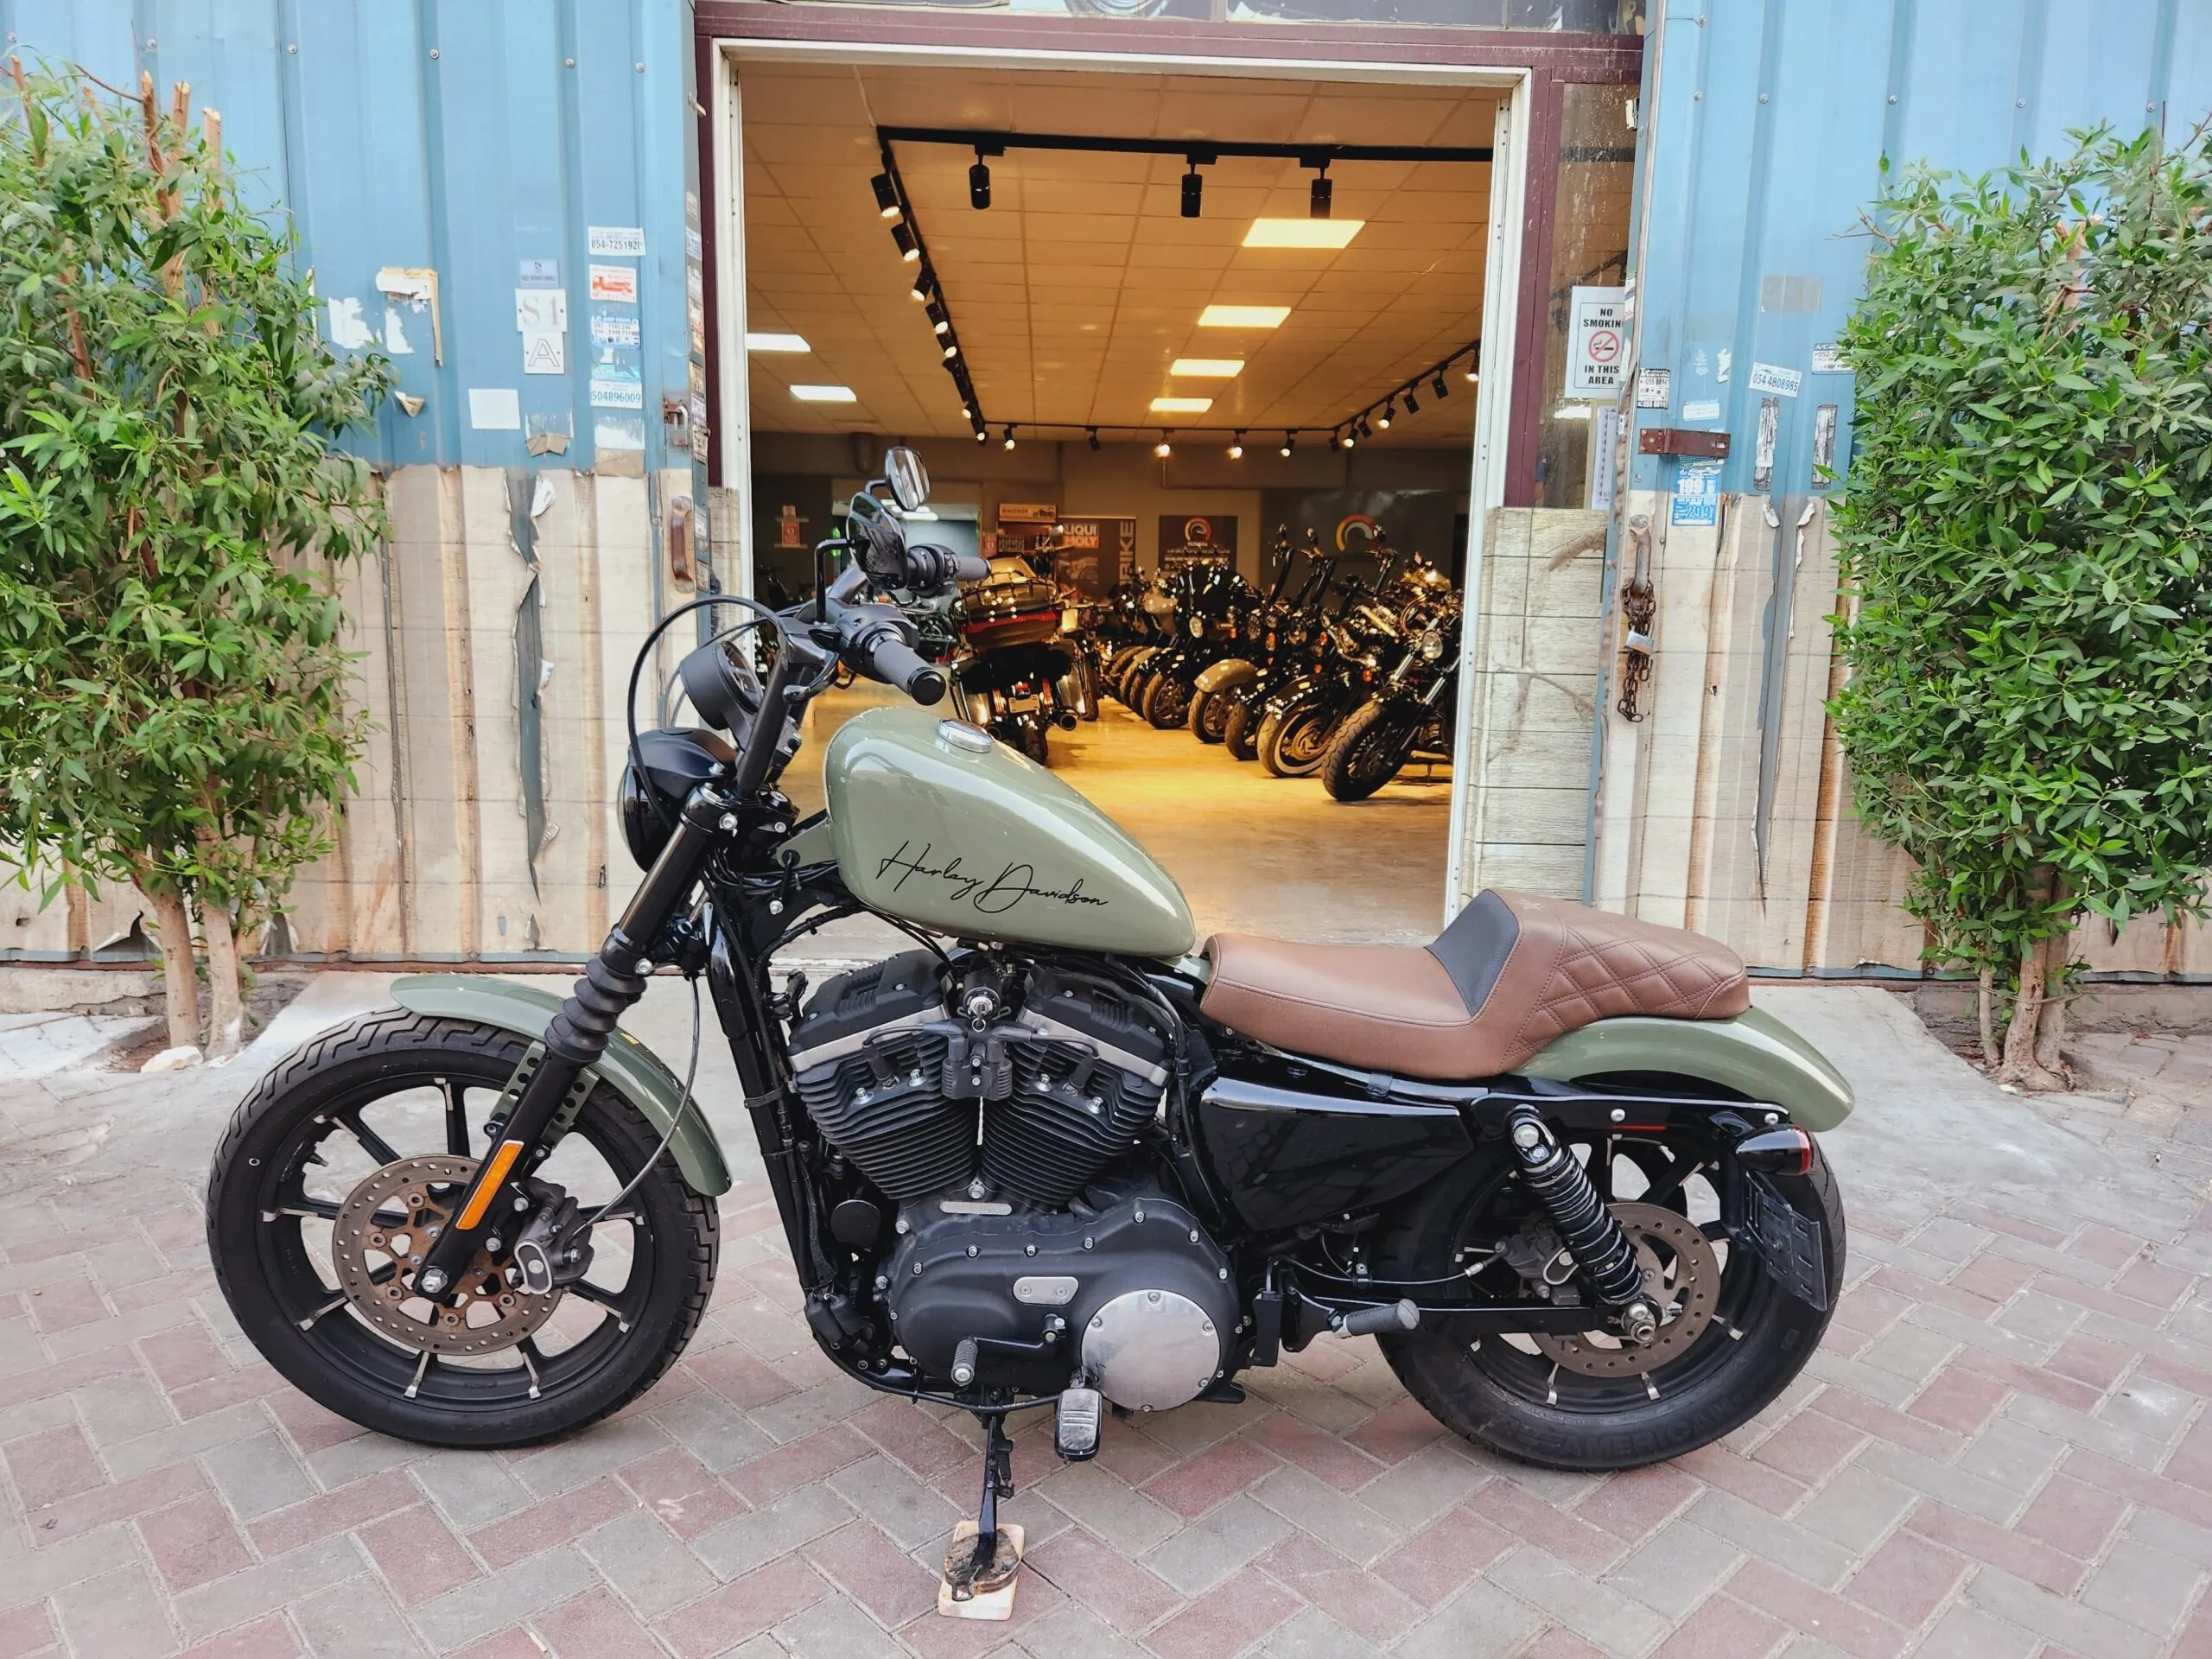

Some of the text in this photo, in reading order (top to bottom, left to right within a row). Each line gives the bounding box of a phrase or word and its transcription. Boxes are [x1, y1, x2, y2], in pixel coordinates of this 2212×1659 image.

[1599, 308, 1613, 317] NO
[1583, 319, 1624, 328] SMOKIN
[528, 338, 560, 367] A
[1584, 365, 1619, 374] IN THIS
[1588, 376, 1614, 385] AREA
[1687, 505, 1711, 519] 299
[1064, 525, 1097, 537] LIQUI
[1064, 537, 1097, 547] MOLY
[876, 840, 1109, 913] Harley Davidson
